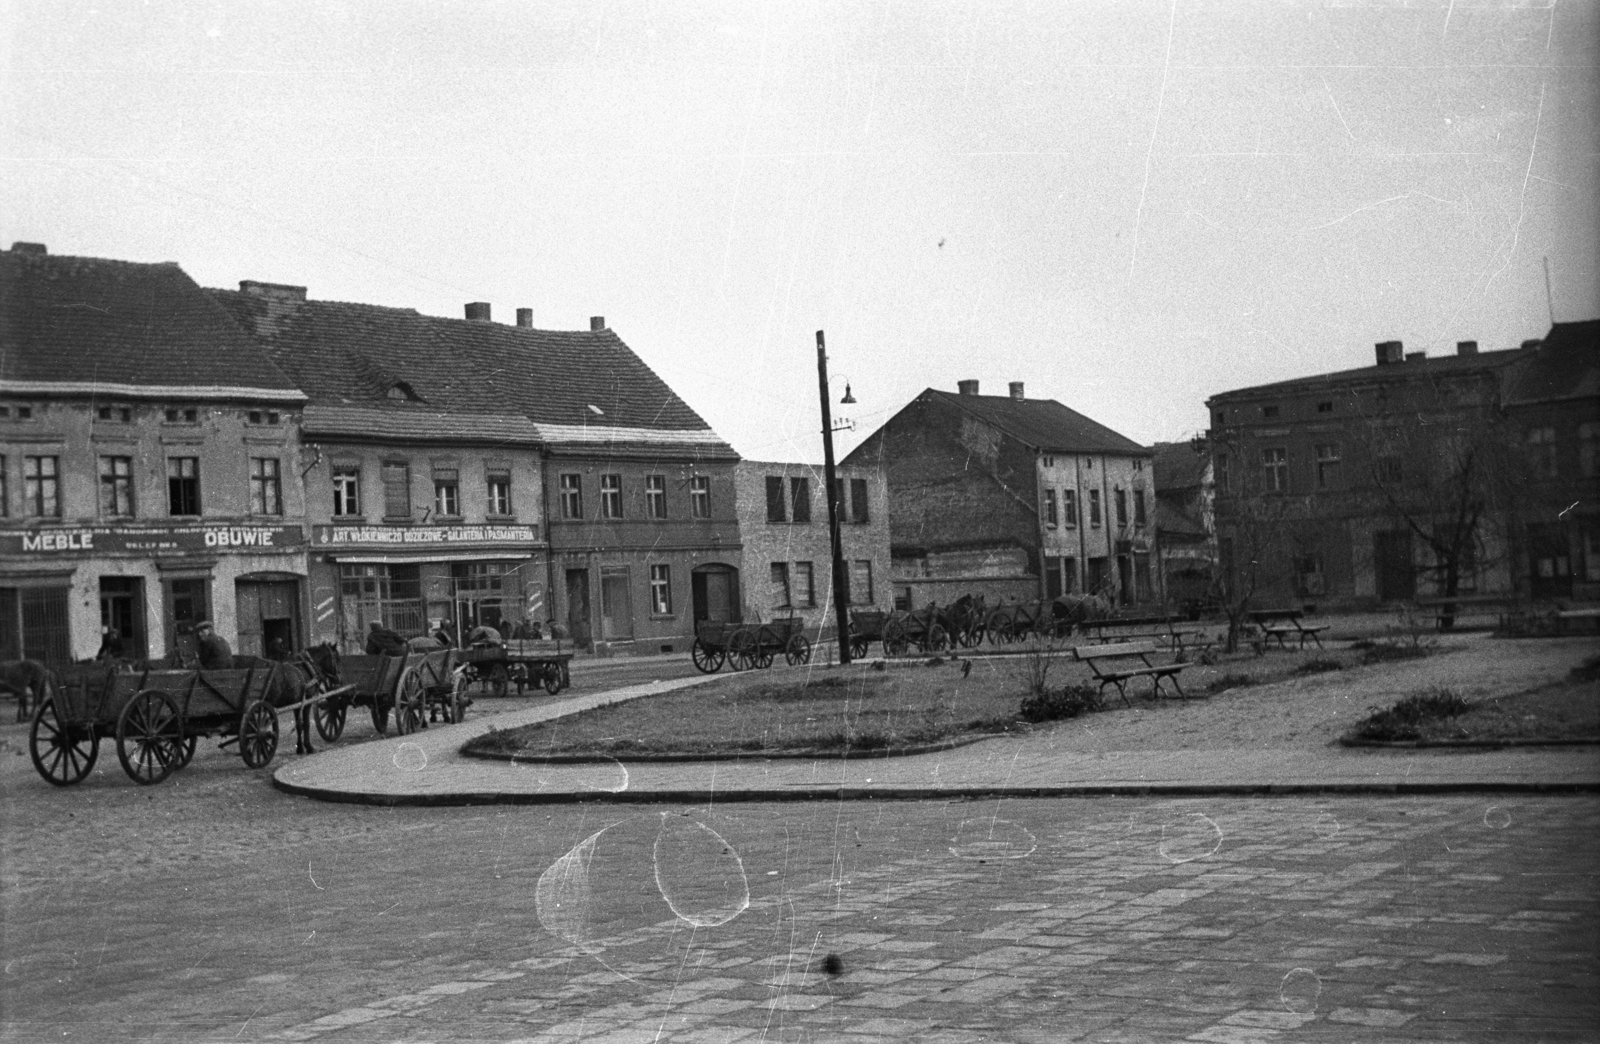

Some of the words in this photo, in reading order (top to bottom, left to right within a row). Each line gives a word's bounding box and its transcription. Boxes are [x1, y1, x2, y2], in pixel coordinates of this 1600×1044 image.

[23, 533, 94, 551] MEBLE
[205, 530, 273, 547] OBUWIE
[488, 530, 534, 540] PASMANTERIA
